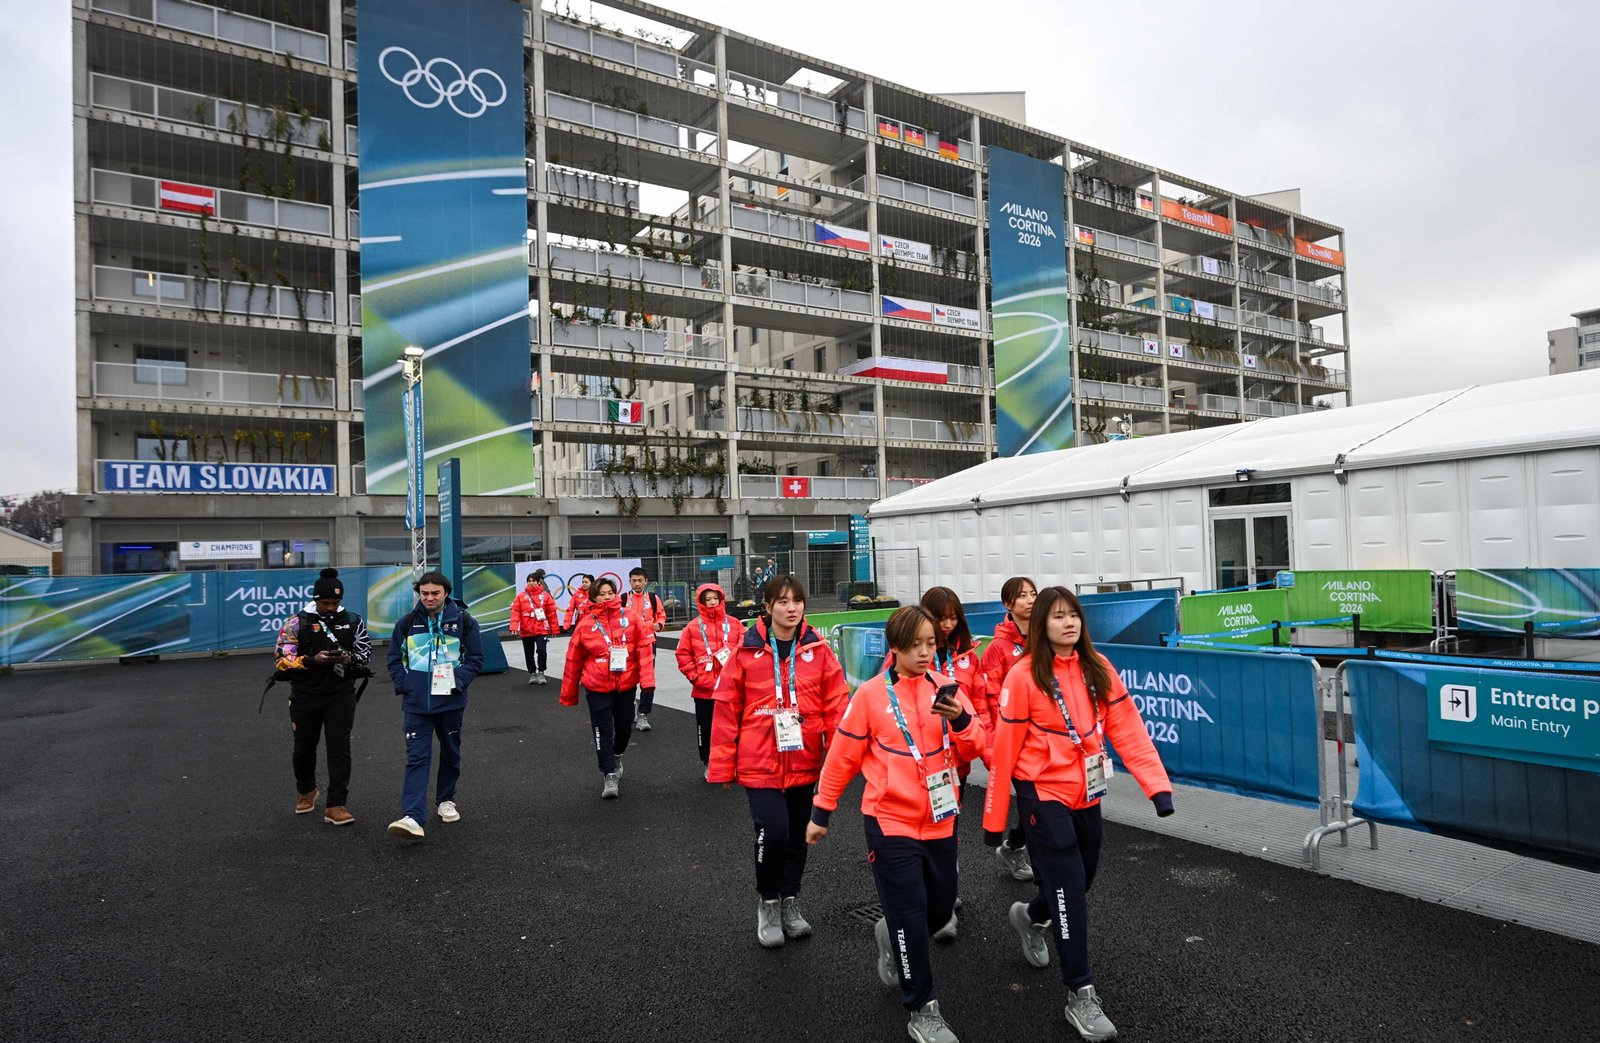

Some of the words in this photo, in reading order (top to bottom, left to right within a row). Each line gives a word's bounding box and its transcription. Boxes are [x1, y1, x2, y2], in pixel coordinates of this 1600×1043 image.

[1000, 202, 1048, 222] MILANO
[1182, 208, 1215, 226] TeamNL
[1009, 217, 1056, 238] CORTINA
[895, 241, 909, 249] CZECH
[1018, 232, 1041, 247] 2026
[895, 249, 915, 258] OLYMPIC
[916, 253, 928, 261] TEAM
[1307, 245, 1333, 260] TeamNL
[948, 317, 966, 325] OLYMPIC
[111, 464, 190, 488] TEAM
[200, 465, 327, 490] SLOVAKIA
[225, 586, 315, 600] MILANO
[1322, 581, 1371, 590] MILANO
[1330, 592, 1382, 602] CORTINA
[242, 602, 307, 616] CORTI
[1218, 603, 1252, 616] MILANO
[1340, 604, 1363, 613] 2026
[1224, 615, 1259, 627] CORTINA
[1132, 694, 1214, 723] ORTINA
[1491, 688, 1576, 713] Entrata
[1145, 720, 1179, 744] 026
[1491, 714, 1527, 729] Main
[1532, 720, 1570, 738] Entry
[1056, 888, 1065, 912] TEAM
[1059, 912, 1070, 939] JAPAN
[898, 928, 907, 953] TEAM
[901, 953, 911, 980] JAPAN
